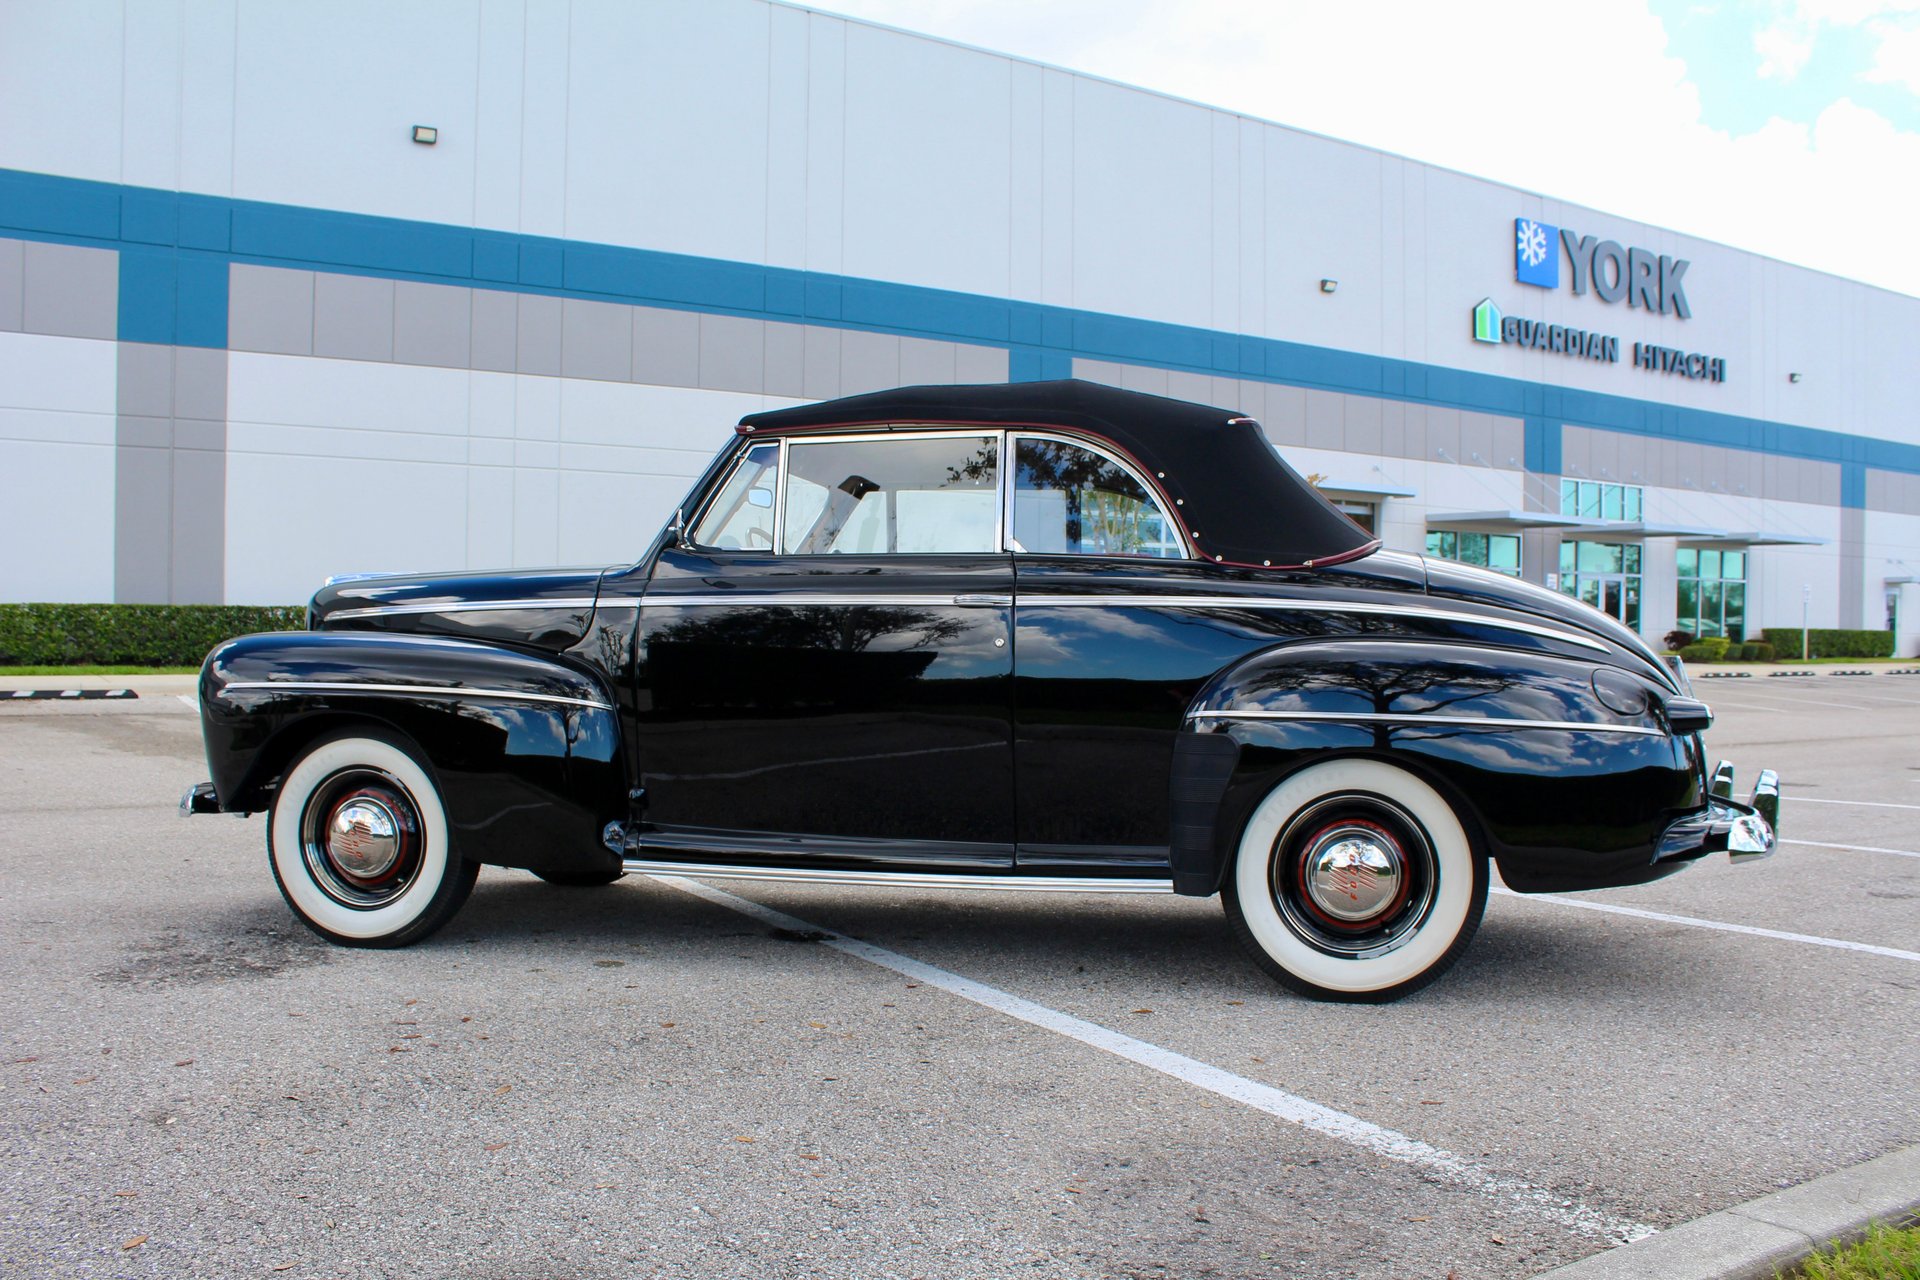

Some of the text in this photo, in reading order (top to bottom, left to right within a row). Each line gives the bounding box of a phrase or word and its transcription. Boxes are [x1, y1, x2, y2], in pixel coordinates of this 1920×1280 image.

[1561, 229, 1691, 319] YORK
[1502, 316, 1726, 382] GUARDIAN HITACHI
